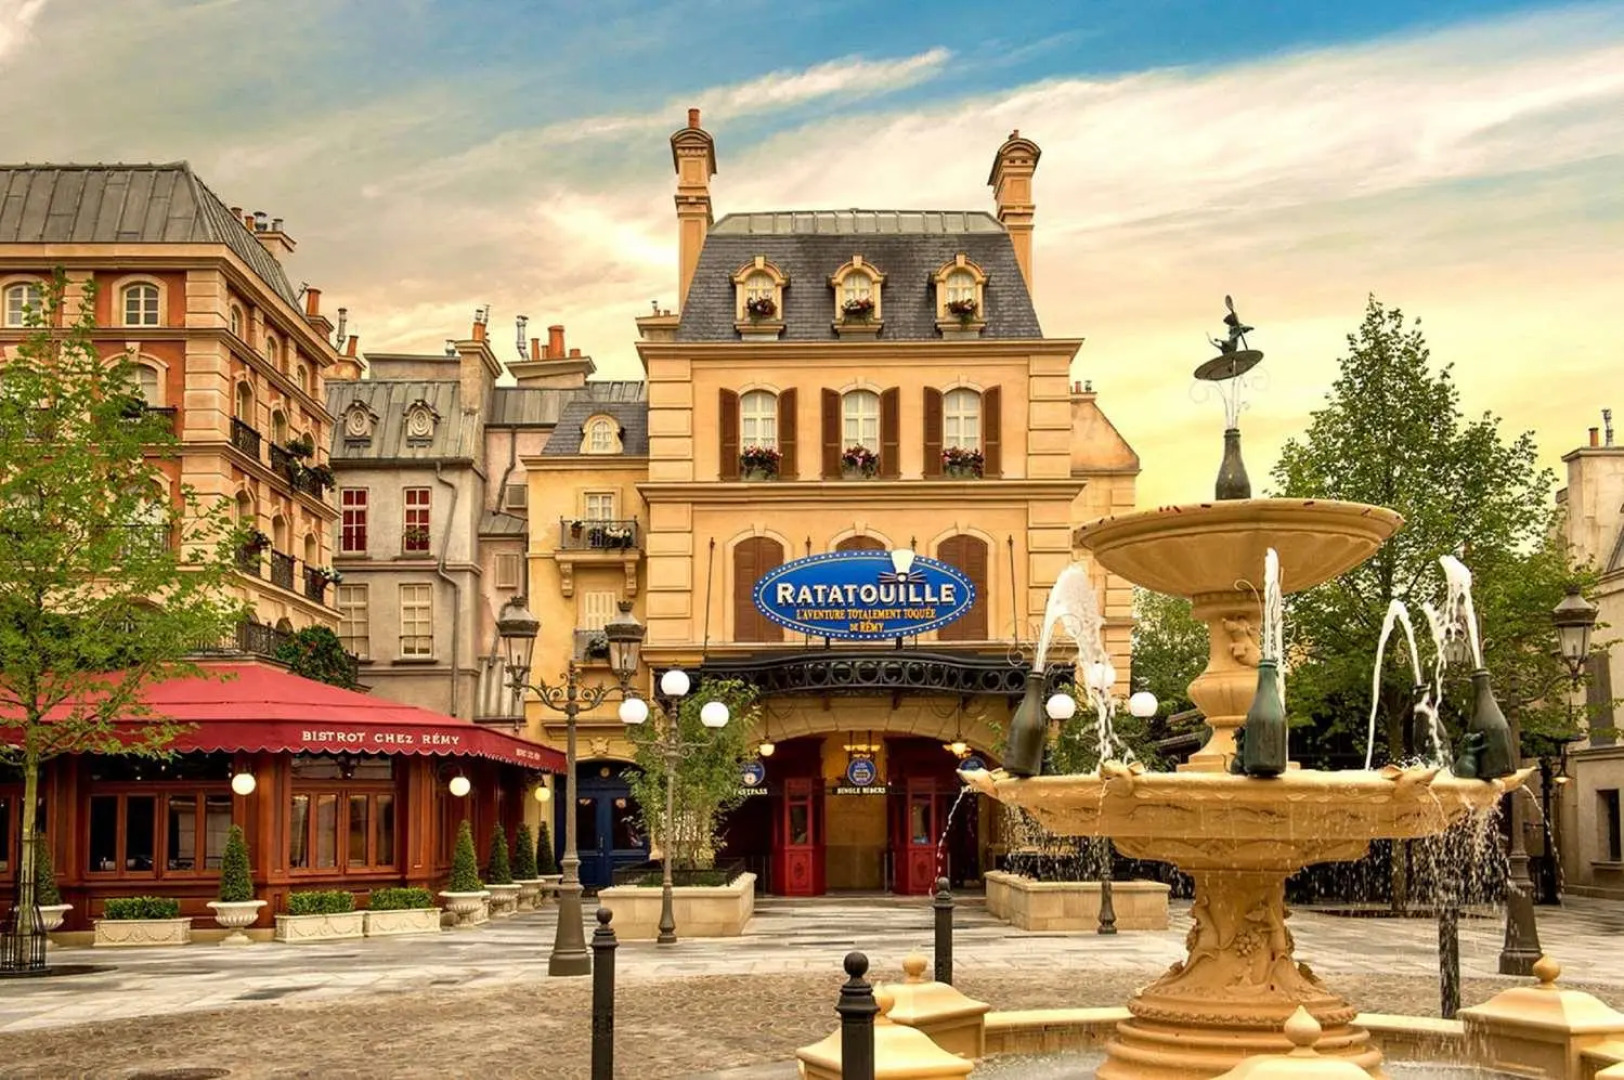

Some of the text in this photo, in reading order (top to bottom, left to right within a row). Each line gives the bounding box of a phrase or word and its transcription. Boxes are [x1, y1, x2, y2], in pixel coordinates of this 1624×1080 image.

[776, 583, 956, 604] RATATOUILLE
[797, 606, 936, 620] L'AVENTURE TOTALEMENT TOQUÉE
[860, 620, 884, 632] RÉMY
[302, 731, 460, 745] BISTROT CHEZ RÉMY
